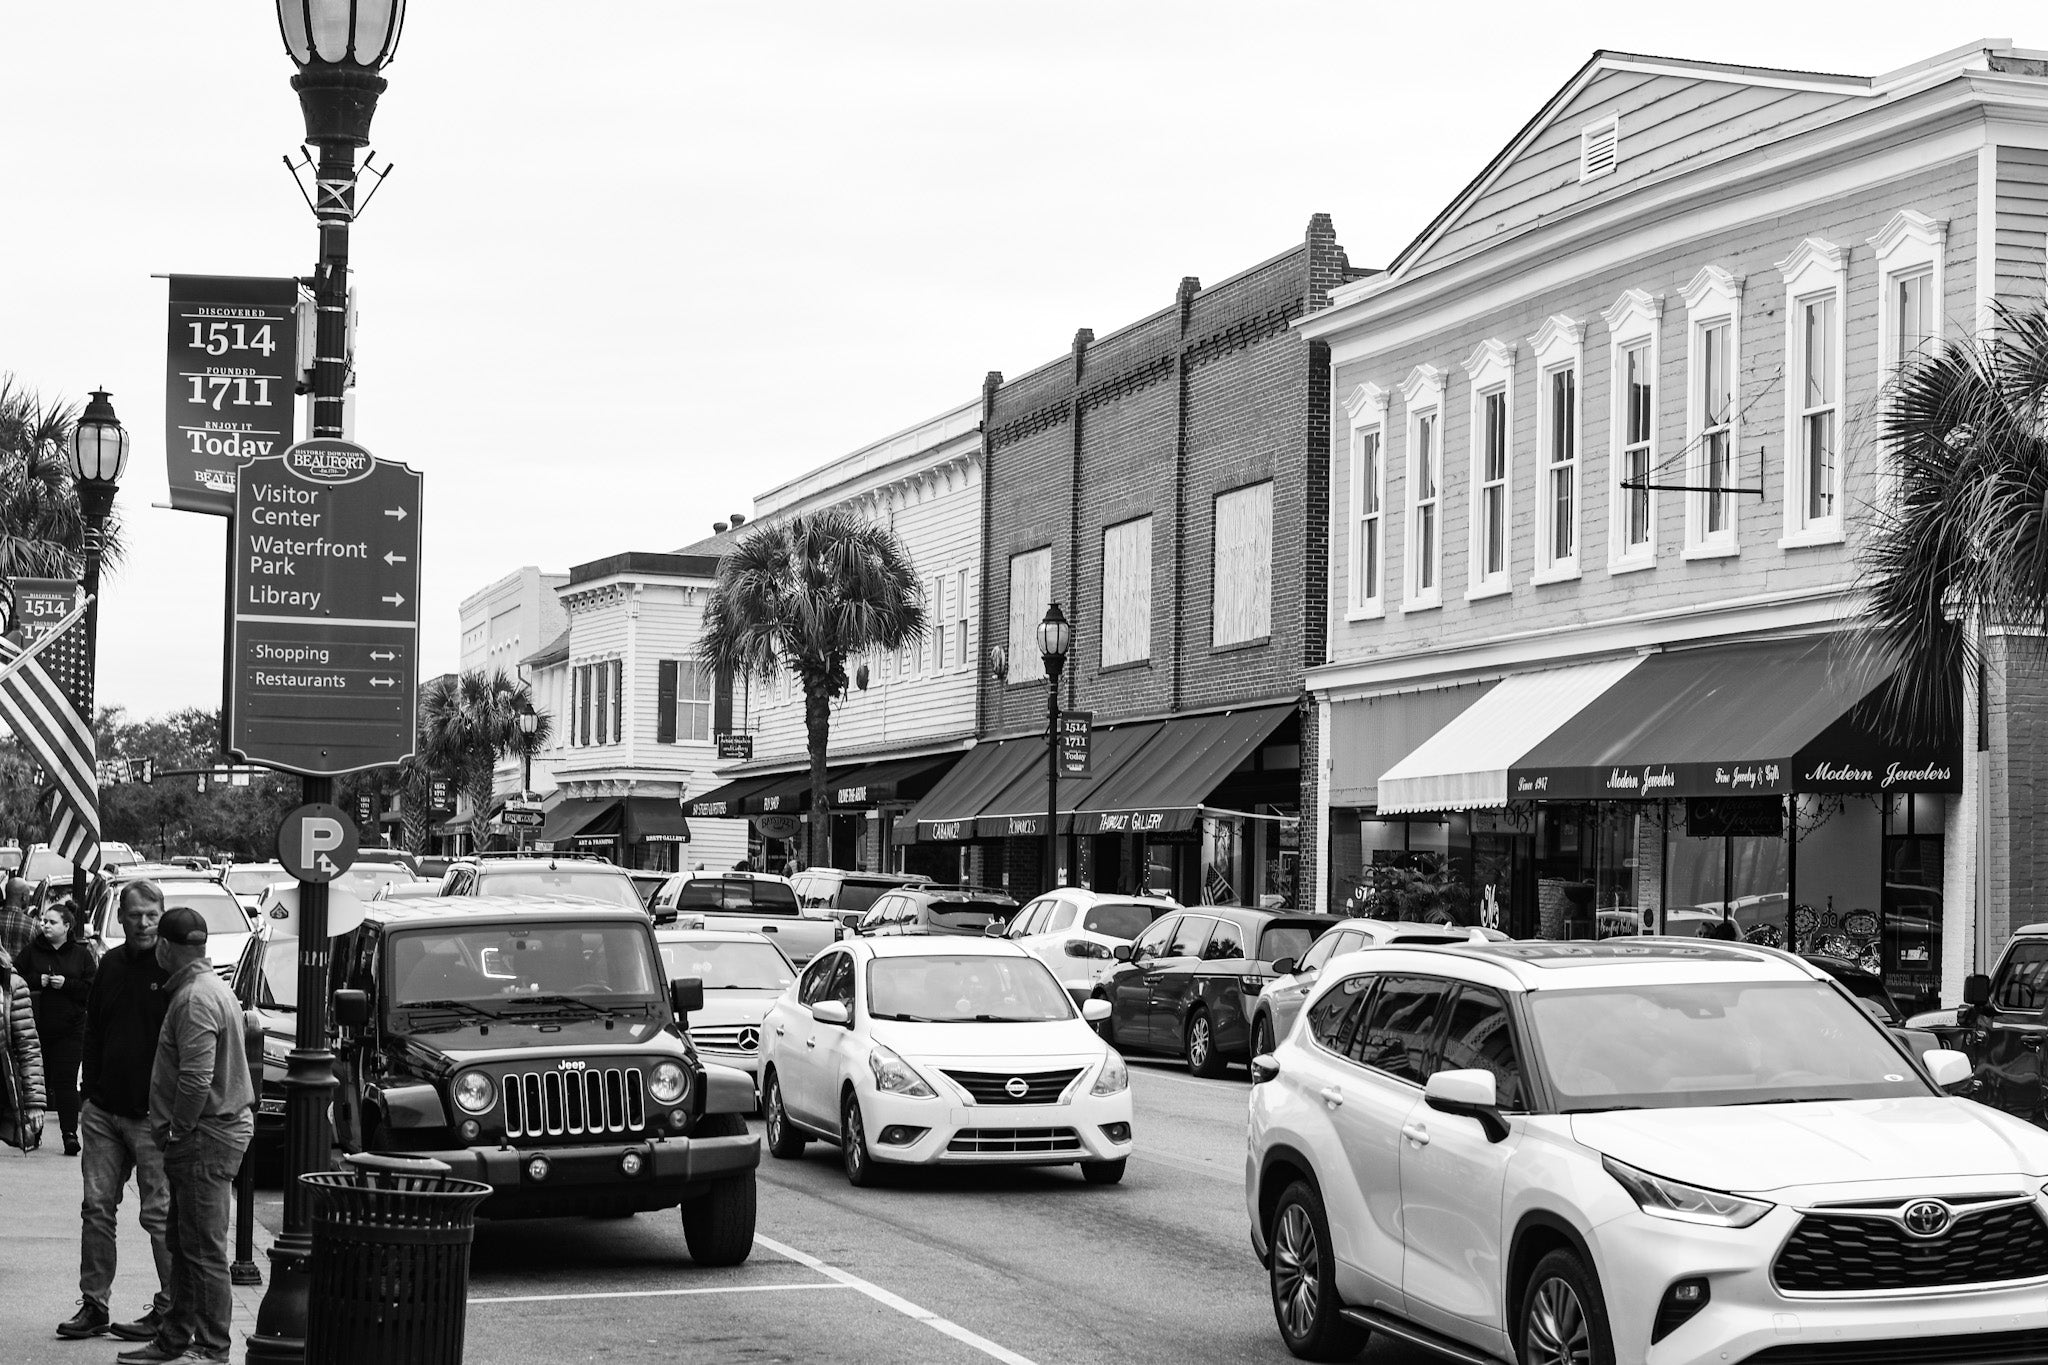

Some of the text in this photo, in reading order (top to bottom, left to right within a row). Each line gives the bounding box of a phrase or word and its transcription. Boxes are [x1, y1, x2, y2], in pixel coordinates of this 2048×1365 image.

[198, 307, 265, 317] DISCOVERED
[188, 321, 276, 357] 1514
[206, 366, 256, 376] FOUNDED
[188, 376, 272, 411] 1711
[205, 421, 252, 431] ENJOY IT
[293, 454, 366, 469] BEAUFORT
[252, 484, 318, 505] Visitor
[251, 507, 321, 528] Center
[250, 535, 367, 559] Waterfront
[250, 556, 296, 576] Park
[250, 585, 321, 610] Library
[25, 600, 67, 617] 1514
[255, 644, 330, 664] Shopping
[255, 671, 346, 688] Restaurants
[1066, 723, 1087, 733] 1514
[1065, 737, 1086, 748] 1711
[1065, 750, 1087, 762] Today
[1607, 765, 1675, 797] Modern Jewelers
[1805, 761, 1951, 788] Modern Jewelers
[1517, 777, 1533, 792] Since
[1131, 812, 1164, 830] GALLERY
[301, 817, 344, 869] P
[558, 1060, 586, 1071] Jeep
